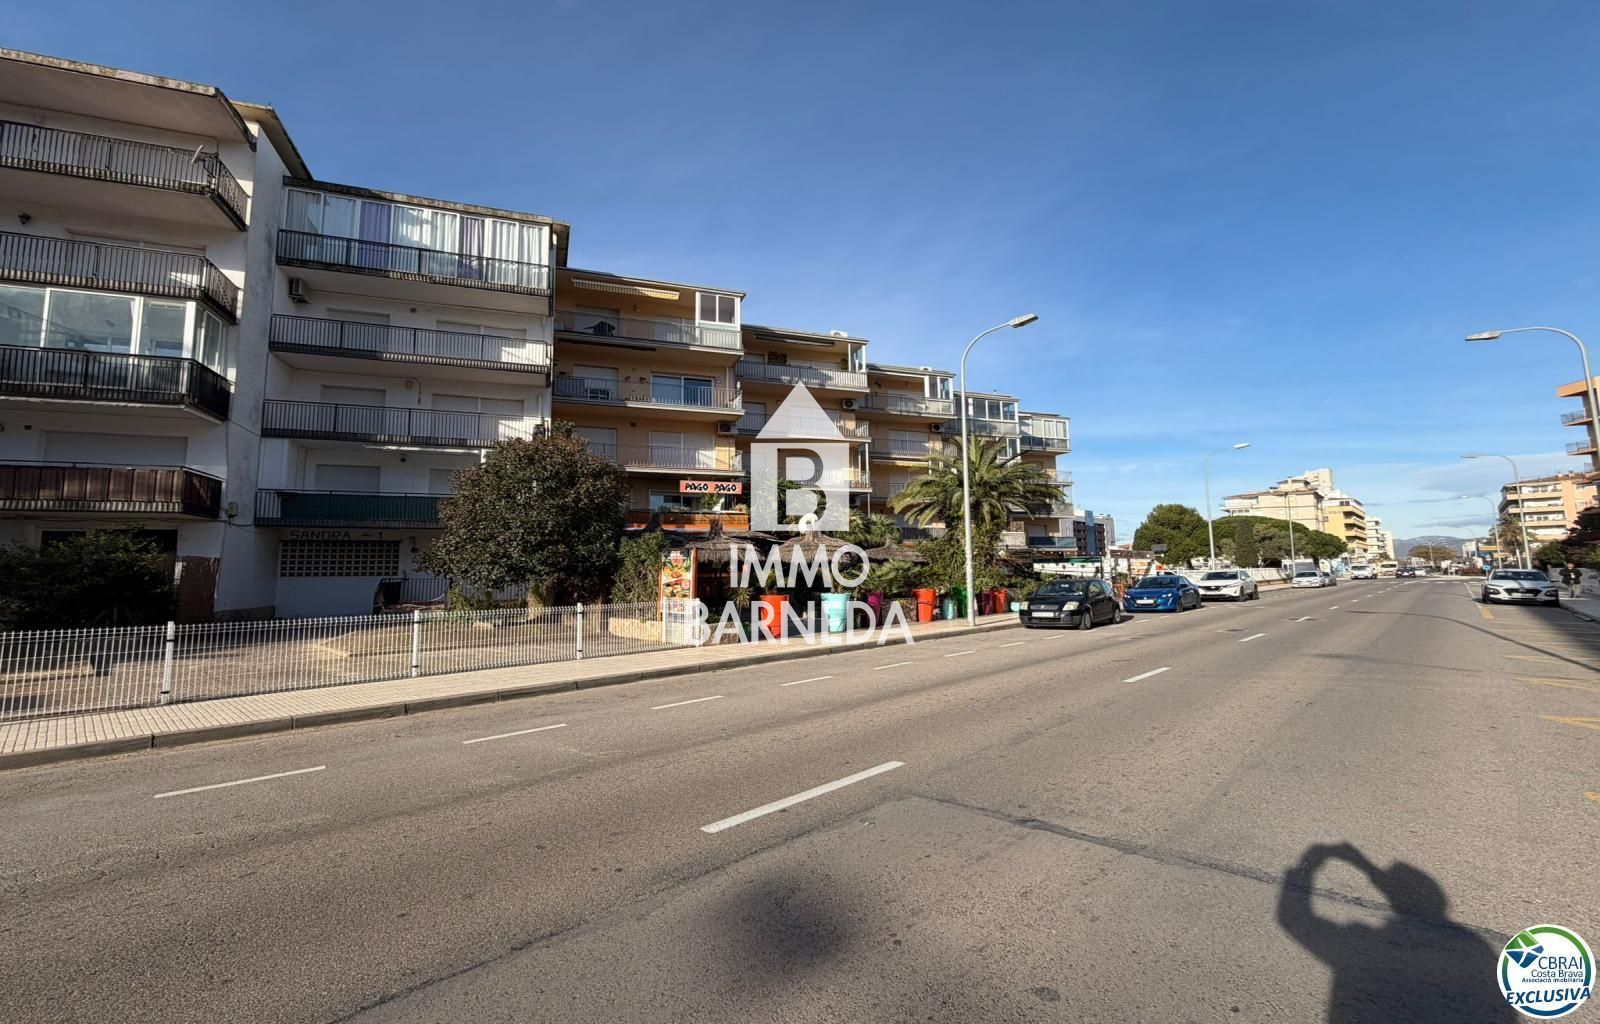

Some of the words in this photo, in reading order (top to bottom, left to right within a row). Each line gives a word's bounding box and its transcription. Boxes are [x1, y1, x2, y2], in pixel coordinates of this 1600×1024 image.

[684, 483, 709, 491] PAGO
[714, 484, 737, 492] PAGO
[289, 530, 351, 540] SANDRA
